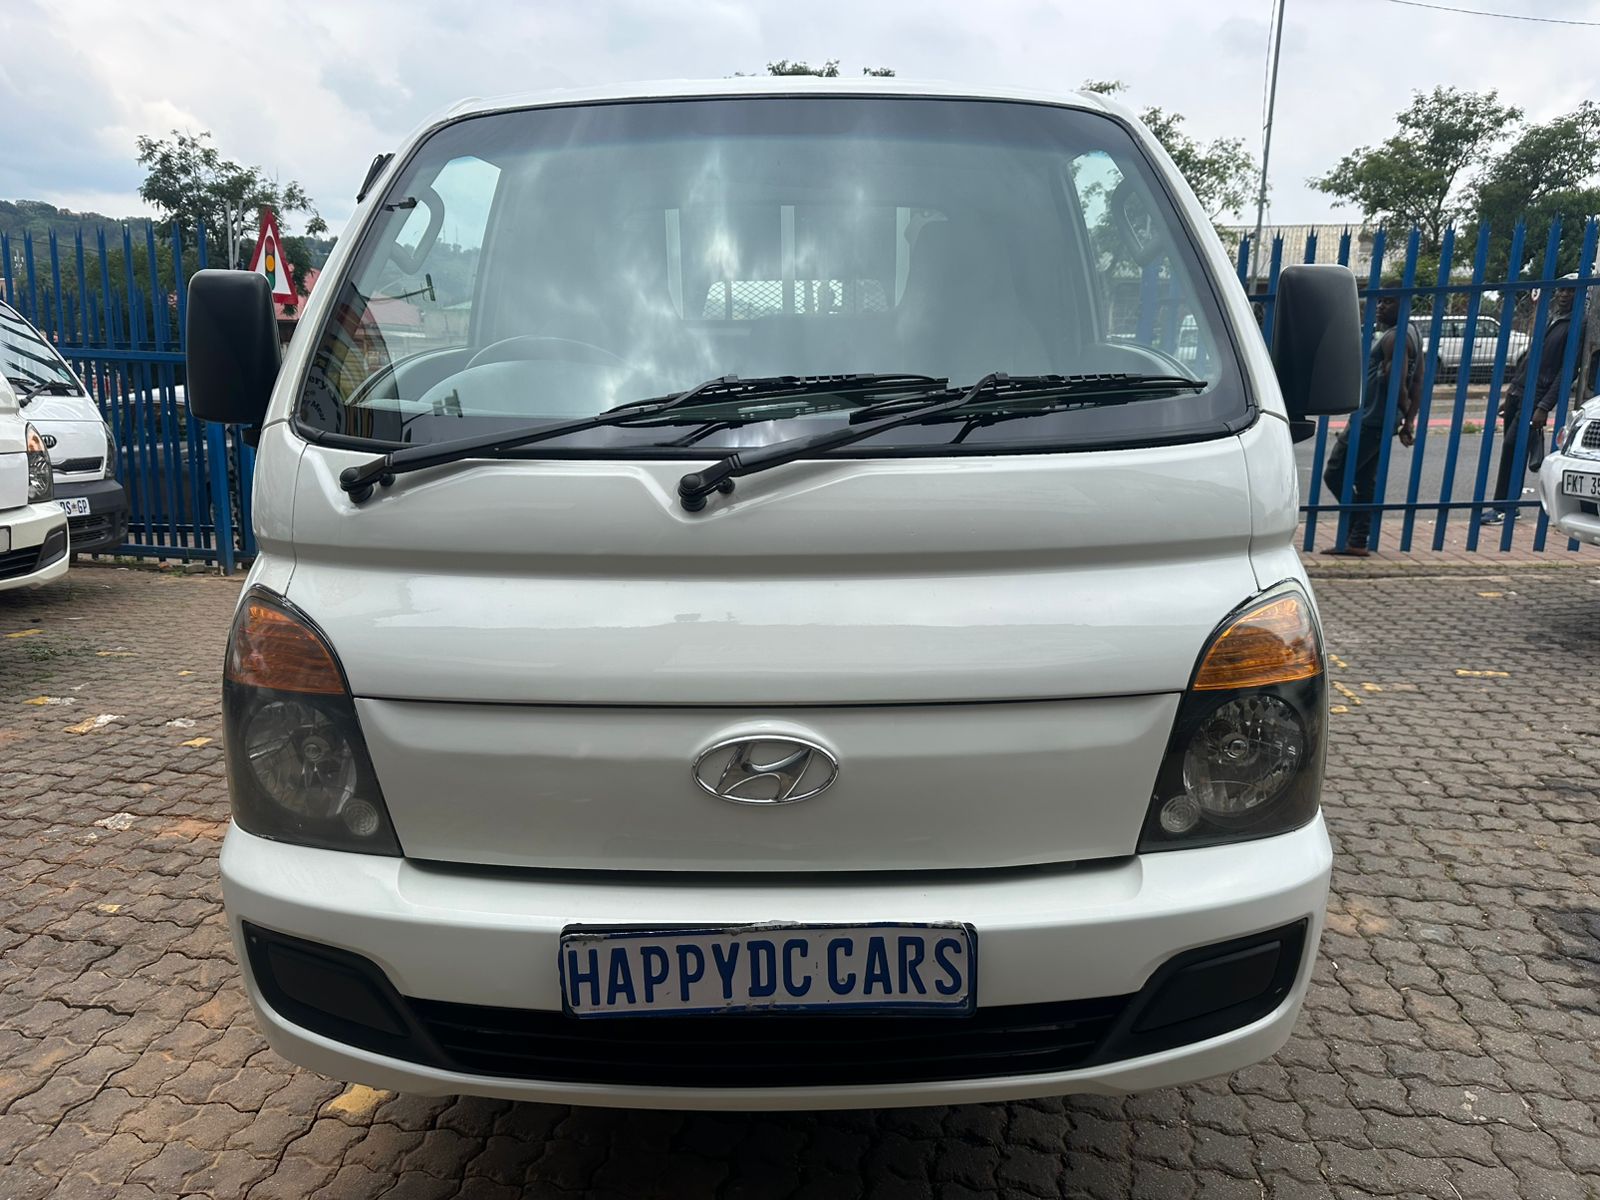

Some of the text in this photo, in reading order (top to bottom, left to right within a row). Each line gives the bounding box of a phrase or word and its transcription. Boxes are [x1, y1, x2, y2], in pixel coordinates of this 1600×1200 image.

[1566, 474, 1584, 493] FKT
[77, 499, 88, 514] GP
[567, 936, 962, 1007] HAPPYDC CARS
